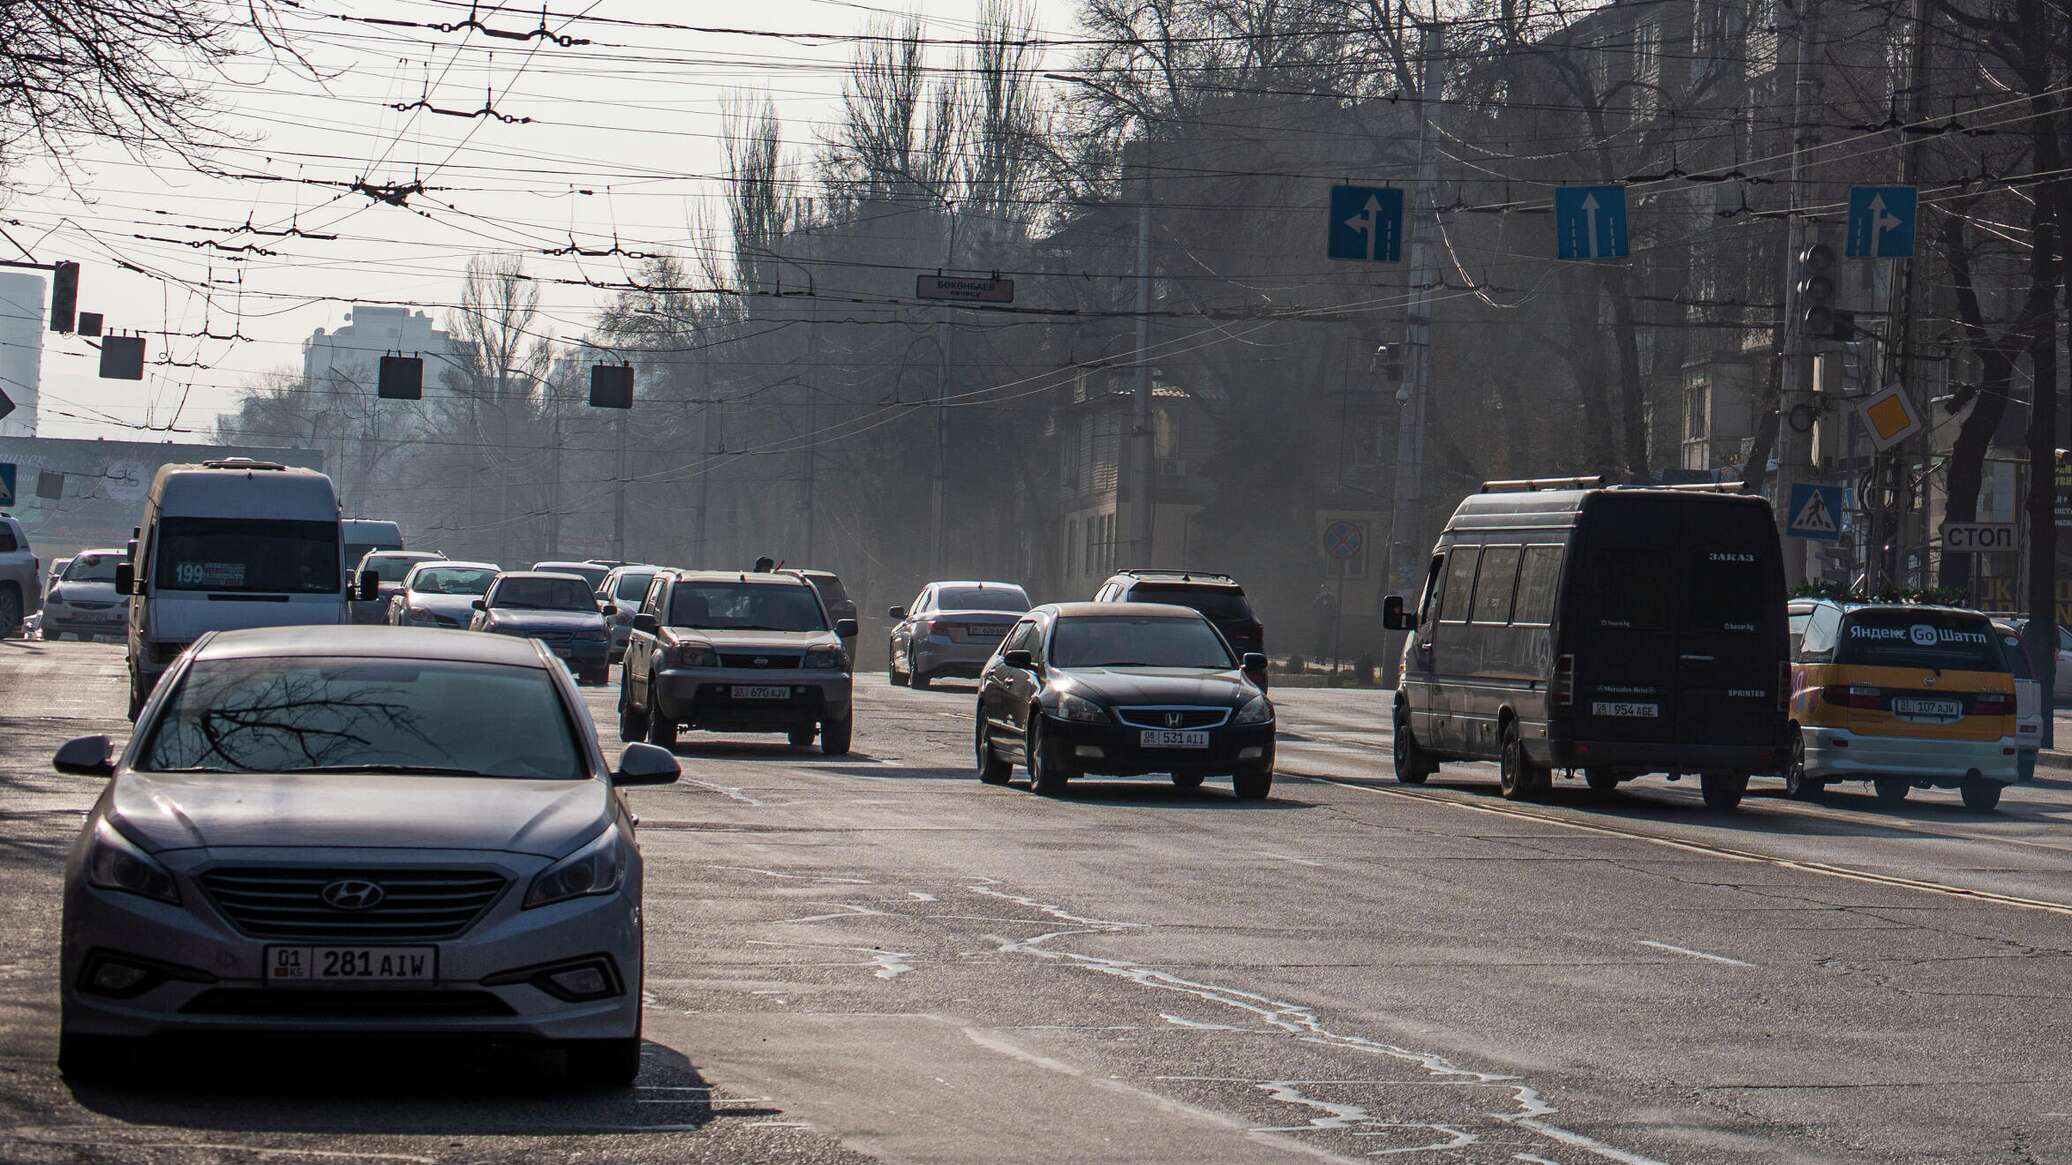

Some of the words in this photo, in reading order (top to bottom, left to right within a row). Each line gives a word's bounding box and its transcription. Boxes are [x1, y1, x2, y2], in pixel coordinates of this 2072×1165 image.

[1948, 527, 2012, 547] СТОП
[1708, 552, 1754, 562] ЗАКАЗ
[176, 564, 203, 584] 199
[1850, 625, 1906, 640] Яндекс
[1913, 628, 1935, 641] Go
[1940, 629, 1987, 643] Шаттл
[1728, 689, 1765, 697] SPRINTER
[1614, 703, 1634, 715] 954
[1918, 701, 1936, 713] 107
[1163, 732, 1184, 744] 531
[277, 949, 301, 967] 01
[322, 950, 378, 977] 281
[380, 954, 424, 977] AIW
